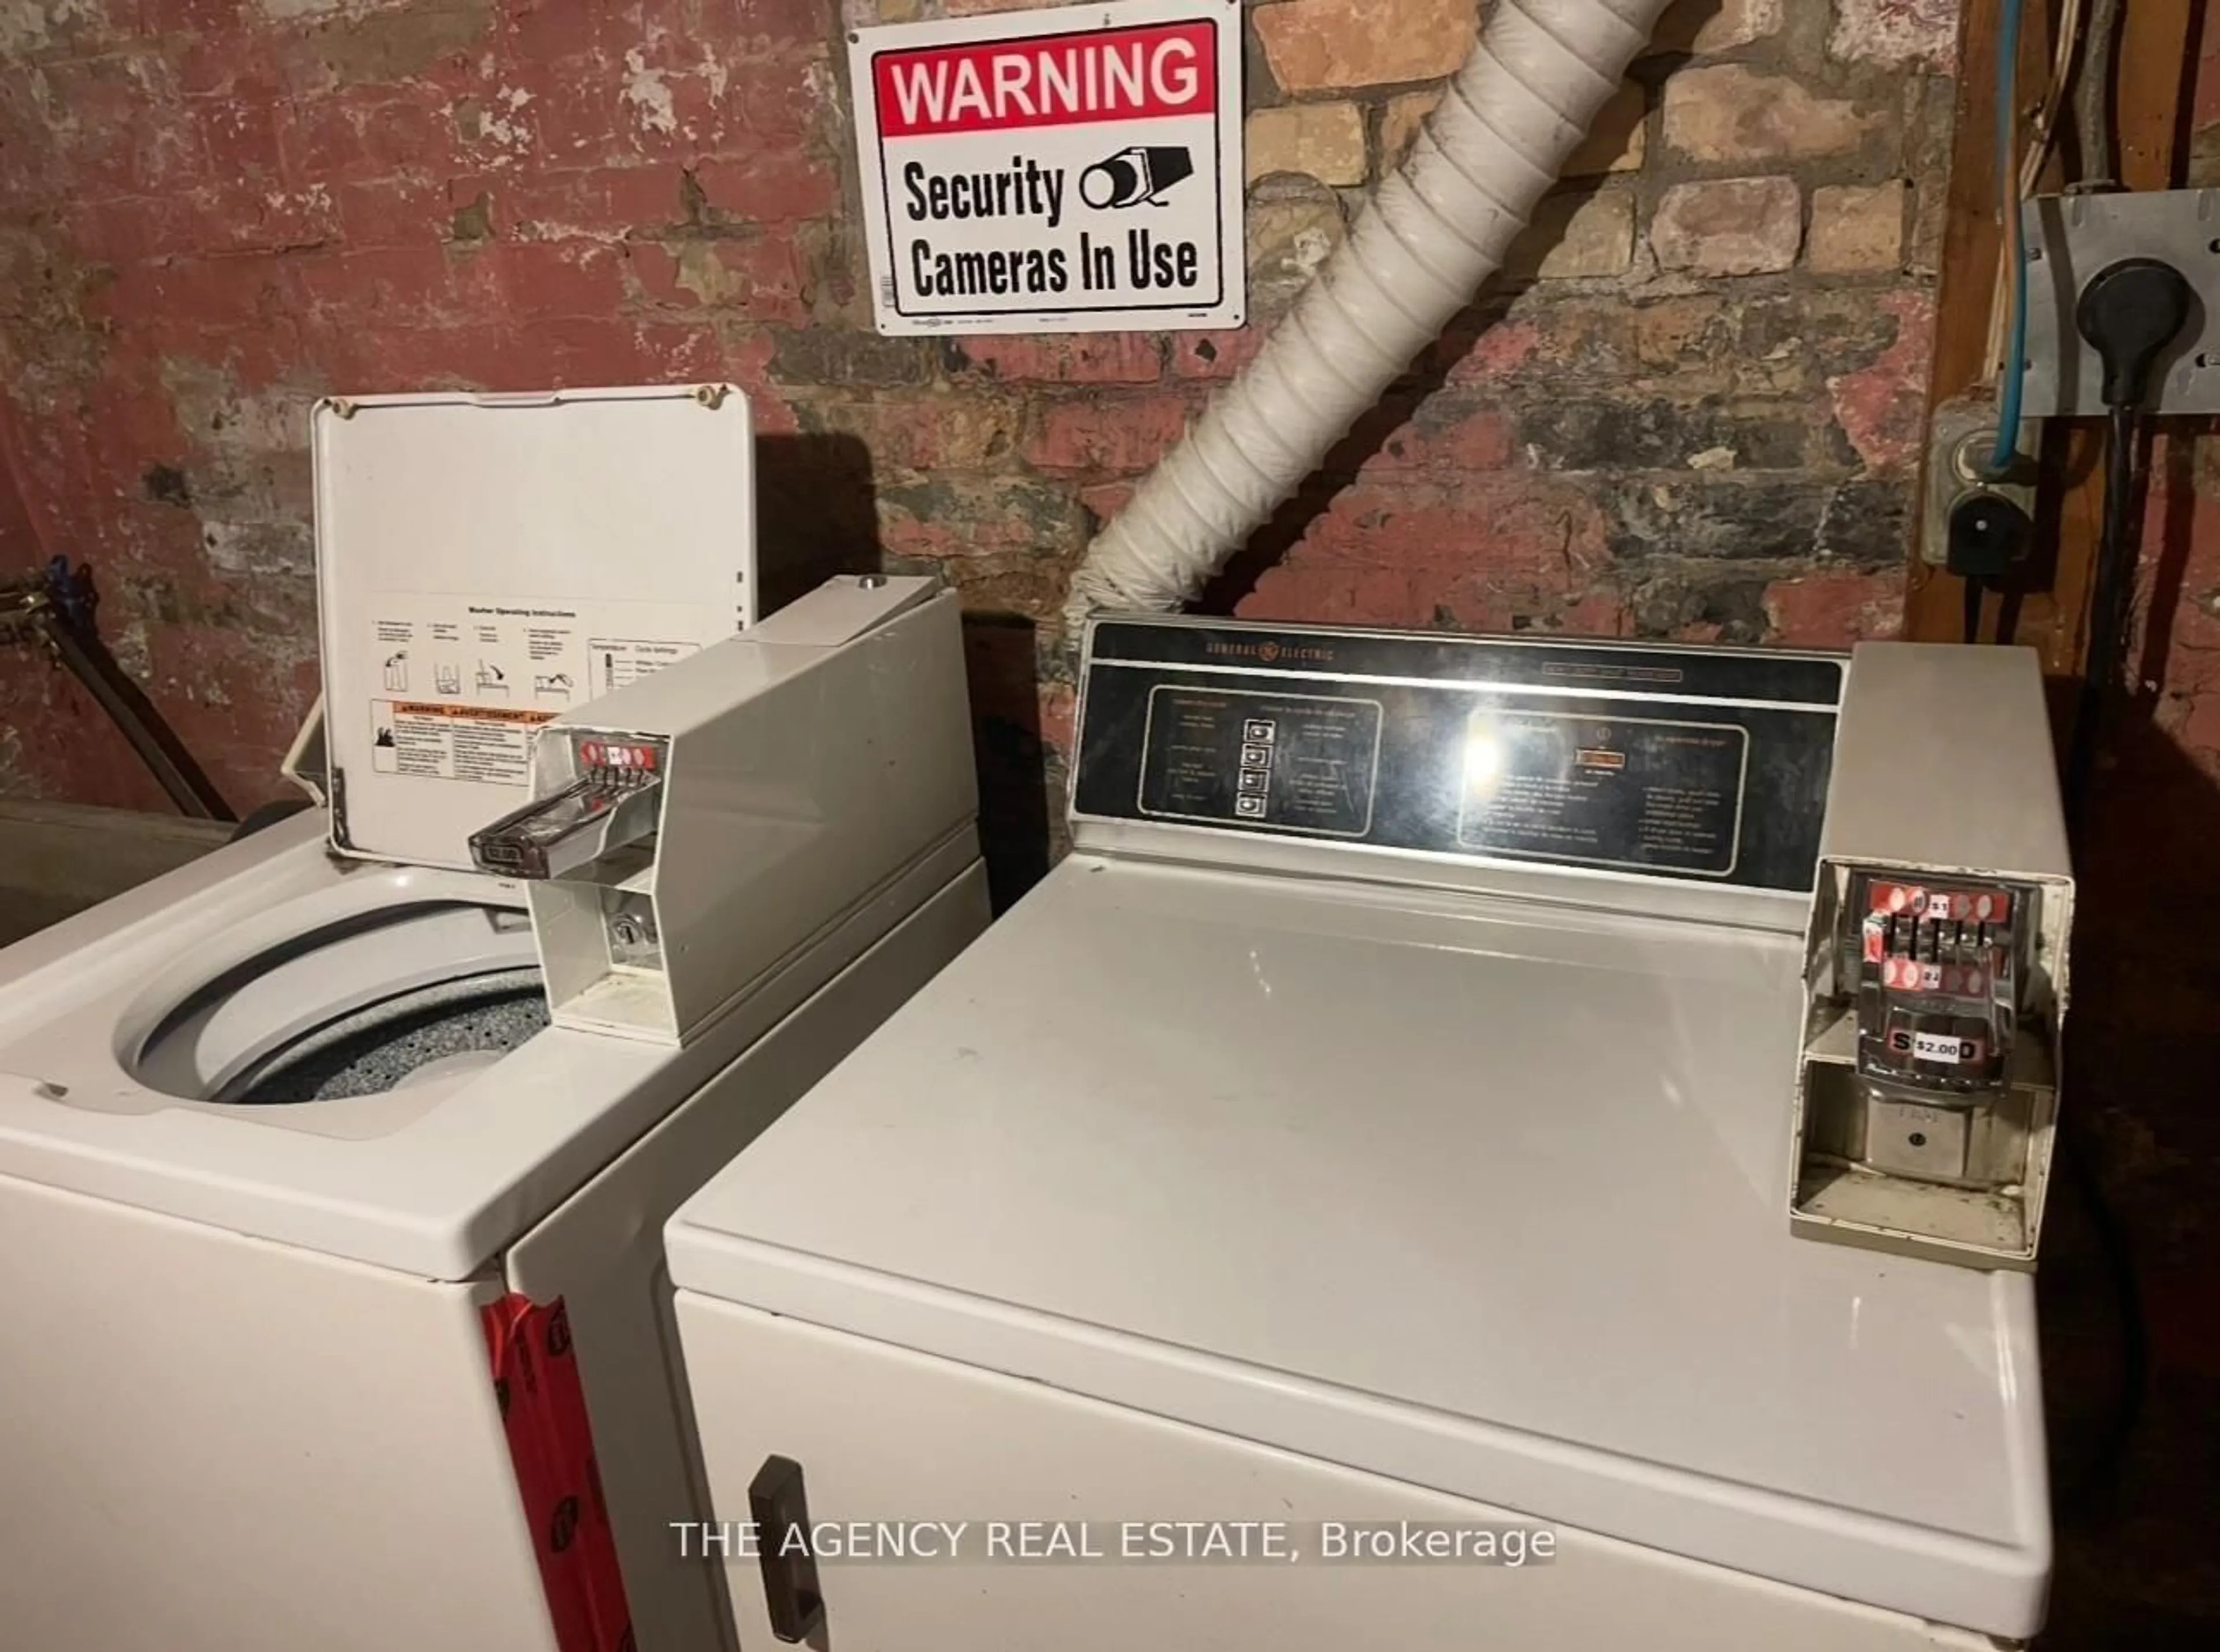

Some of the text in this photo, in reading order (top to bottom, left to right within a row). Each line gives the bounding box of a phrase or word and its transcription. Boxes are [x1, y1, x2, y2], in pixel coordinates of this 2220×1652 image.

[891, 38, 1198, 125] WARNING
[904, 155, 1064, 228] Security
[911, 229, 1198, 297] Cameras In Use
[1916, 1040, 1958, 1055] $2.00
